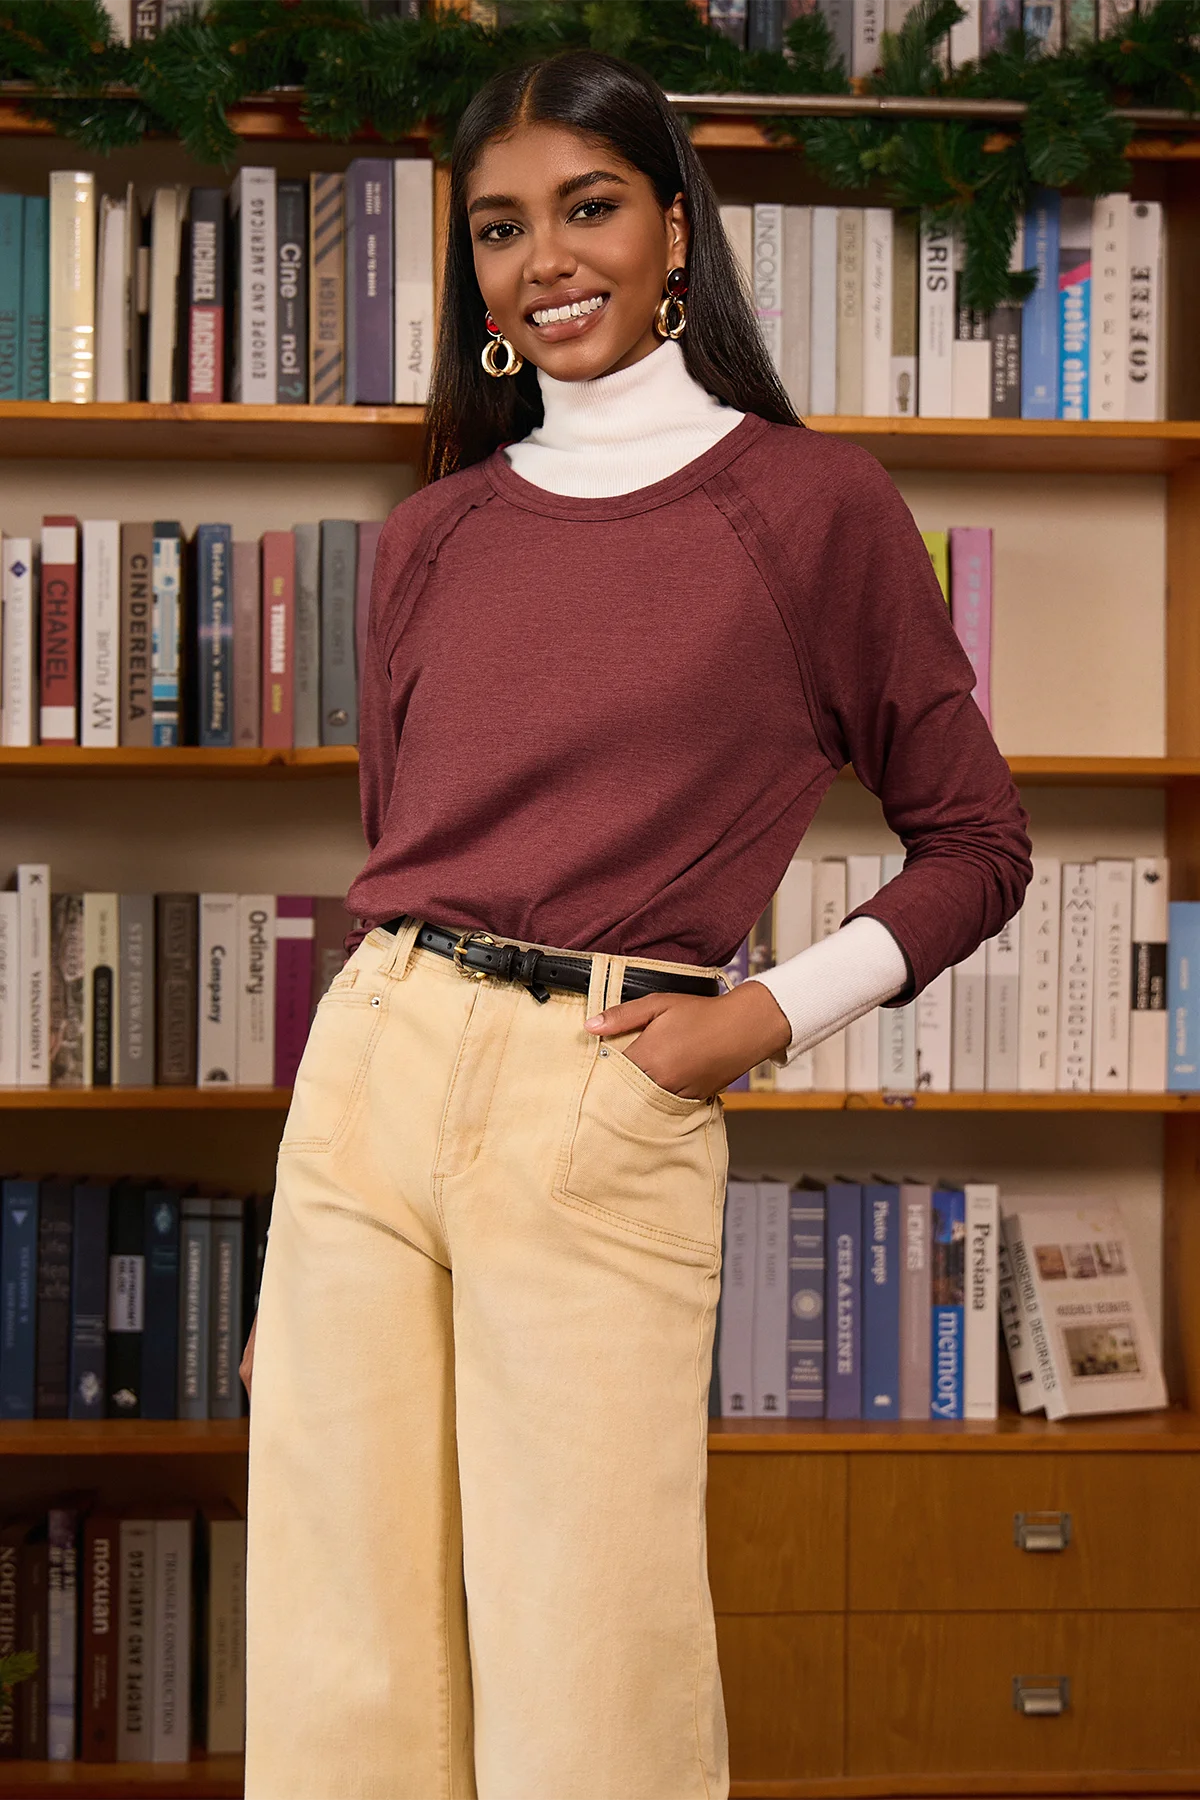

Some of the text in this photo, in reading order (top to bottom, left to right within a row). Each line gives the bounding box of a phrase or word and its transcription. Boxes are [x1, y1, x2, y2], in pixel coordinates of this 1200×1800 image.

[252, 281, 266, 314] AND
[280, 242, 302, 297] Cine
[926, 225, 950, 291] ARIS
[191, 220, 216, 394] MICHAEL JACKSON
[317, 277, 336, 341] DESIGN
[407, 320, 423, 374] About
[1128, 266, 1152, 384] COFFEE
[0, 309, 17, 396] VOGUE
[26, 313, 46, 399] VOGUE
[252, 320, 267, 380] EUROPE
[46, 578, 69, 688] CHANEL
[96, 630, 111, 687] FUTURE
[129, 552, 149, 721] CINDERELLA
[270, 602, 286, 674] TRUMAN
[92, 692, 112, 731] MY
[127, 922, 144, 1059] STEP FORWARD
[207, 945, 227, 1025] Company
[246, 909, 268, 996] Ordinary
[1108, 923, 1121, 1000] KINFOLK
[871, 1200, 890, 1285] Photo props
[907, 1203, 925, 1271] HOMES
[972, 1222, 992, 1312] Persiana
[185, 1239, 201, 1398] NATURAL ENVIRONMENT
[216, 1242, 233, 1398] NATURAL ENVIRONMENT
[1014, 1240, 1058, 1391] HOUSEHOLD DECORATES
[932, 1311, 958, 1420] memory
[93, 1538, 111, 1635] moxuan
[128, 1634, 144, 1667] AND
[161, 1621, 178, 1736] CONSTRUCTION
[126, 1673, 143, 1734] EUROPE
